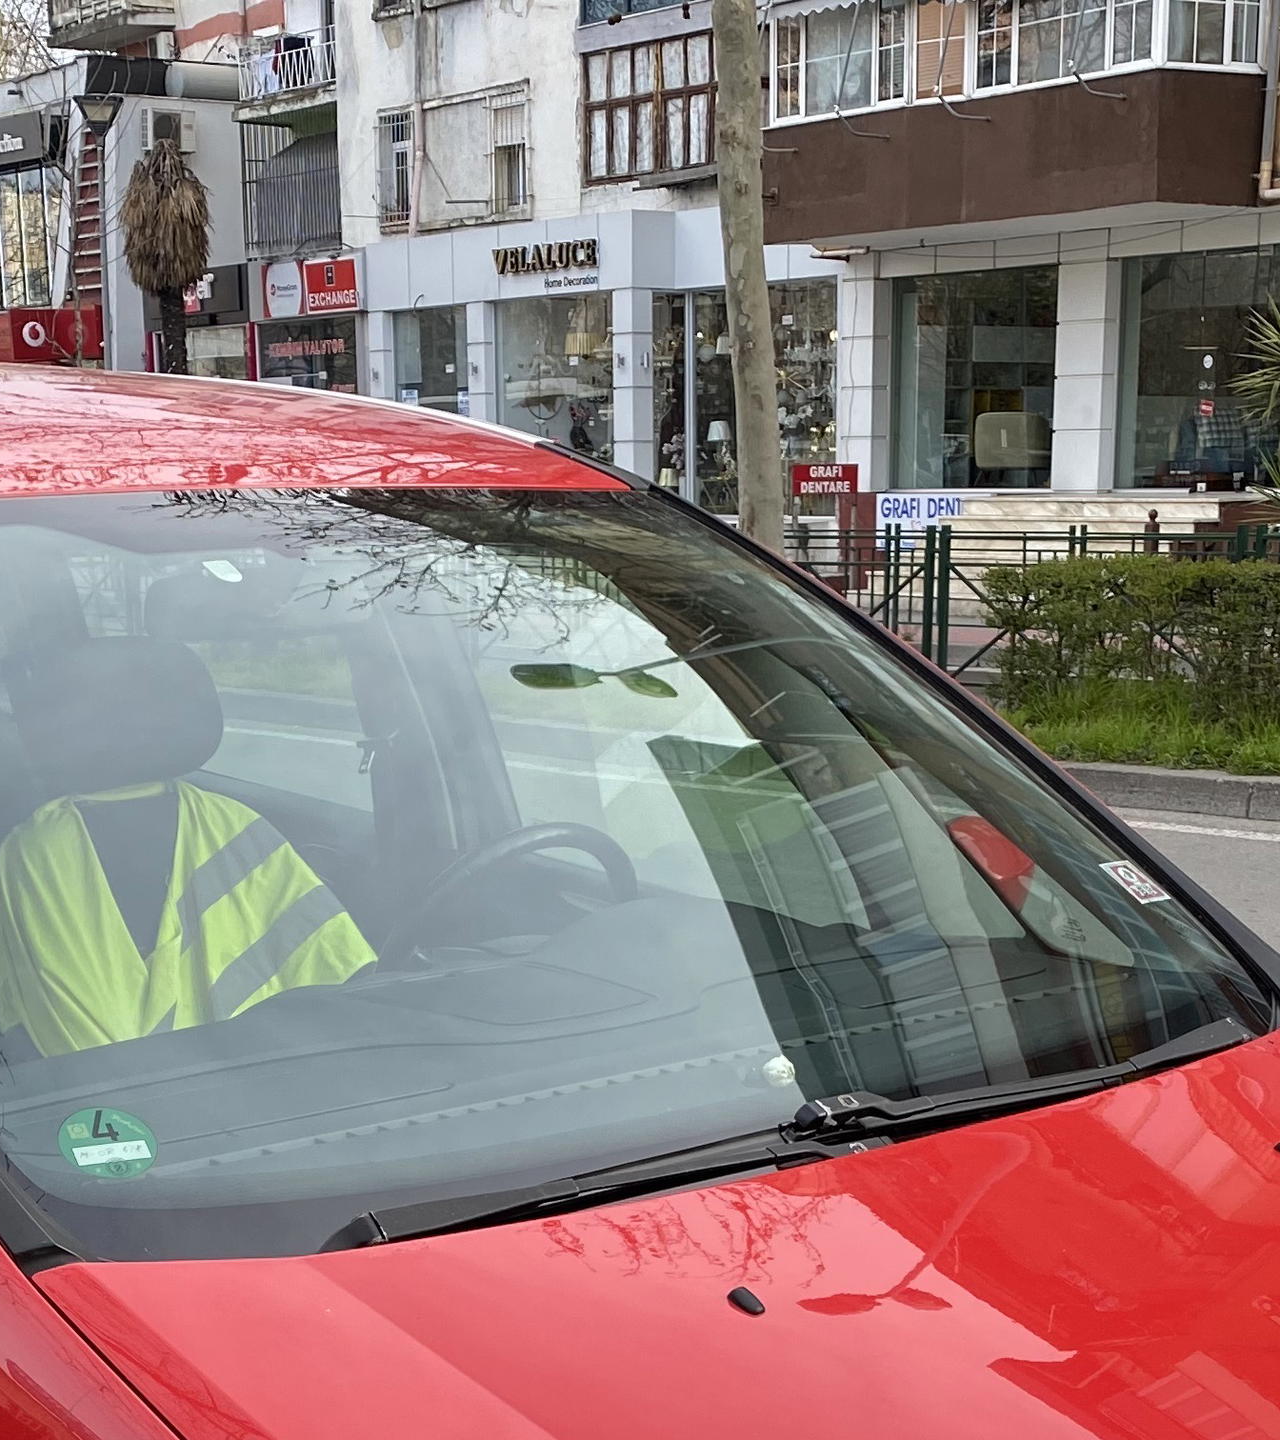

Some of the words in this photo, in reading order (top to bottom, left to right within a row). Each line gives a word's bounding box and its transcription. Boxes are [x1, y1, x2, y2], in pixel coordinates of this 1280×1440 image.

[491, 238, 599, 275] VELALUCE
[544, 277, 562, 288] Home
[563, 274, 599, 287] Decoration
[309, 289, 356, 307] EXCHANGE
[809, 466, 842, 478] GRAFI
[800, 481, 850, 493] DENTARE
[881, 498, 920, 519] GRAFI
[92, 1110, 120, 1142] 4
